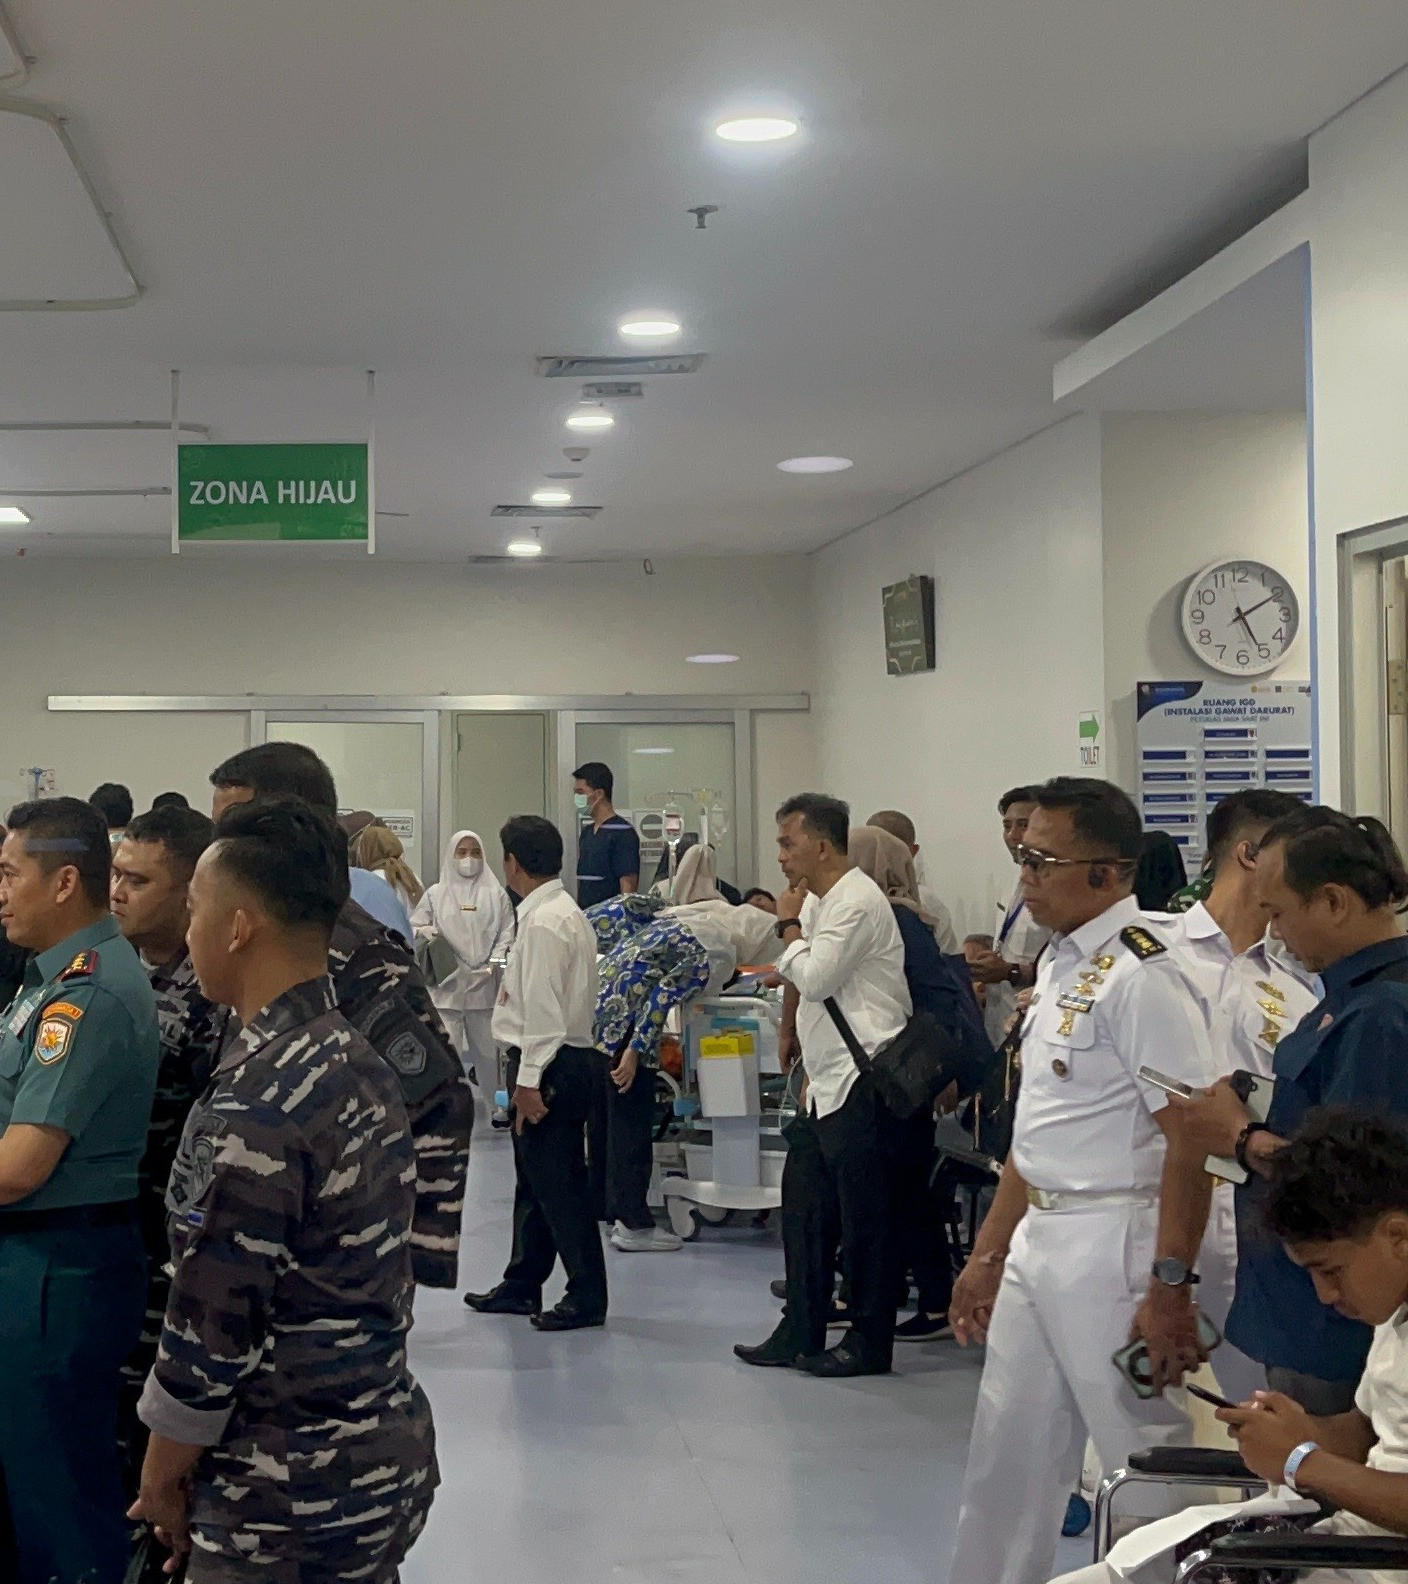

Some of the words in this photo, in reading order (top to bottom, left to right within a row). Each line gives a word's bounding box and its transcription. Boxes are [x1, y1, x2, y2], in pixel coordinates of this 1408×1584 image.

[189, 480, 269, 505] ZONA
[278, 479, 357, 504] HIJAU
[1213, 573, 1225, 588] 11
[1231, 568, 1249, 583] 12
[1260, 572, 1266, 587] 1
[1197, 589, 1216, 605] 10
[1271, 586, 1284, 603] 2
[1192, 608, 1205, 625] 9
[1278, 606, 1292, 623] 3
[1199, 629, 1212, 645] 8
[1272, 627, 1286, 643] 4
[1214, 644, 1227, 659] 7
[1236, 649, 1250, 666] 6
[1257, 642, 1271, 659] 5
[1203, 699, 1236, 707] RUANG
[1250, 706, 1295, 715] DARURAT)
